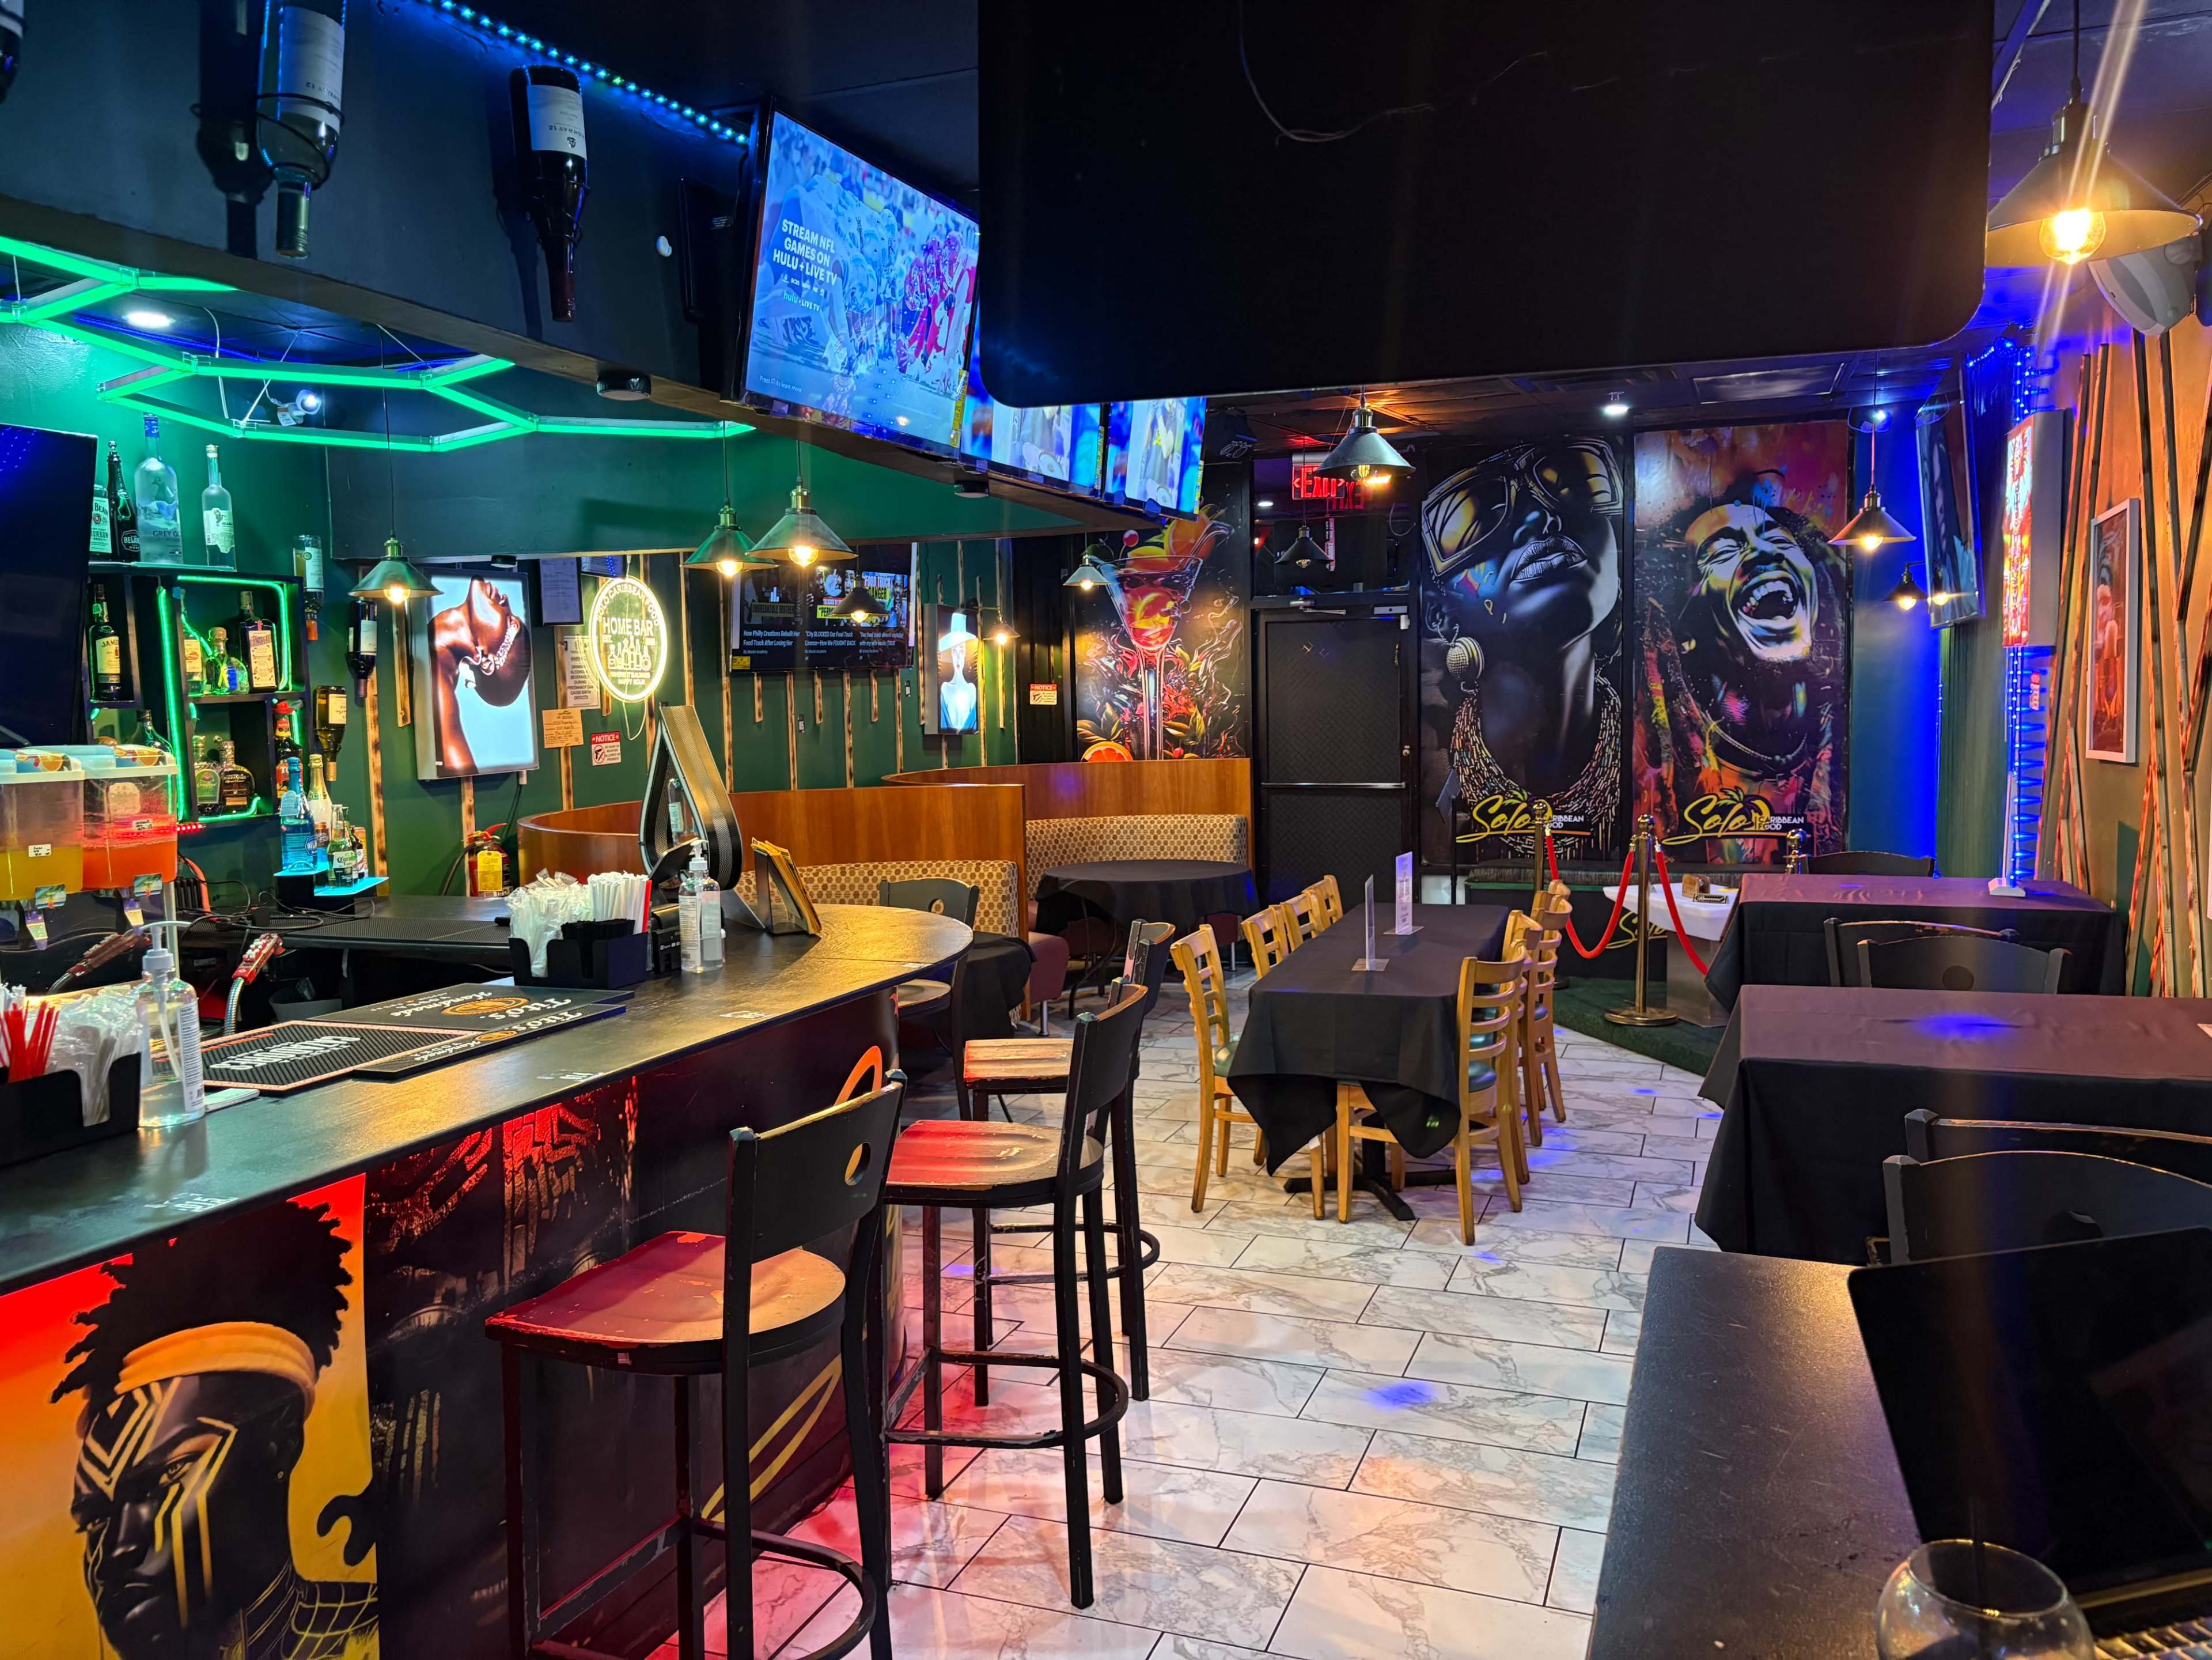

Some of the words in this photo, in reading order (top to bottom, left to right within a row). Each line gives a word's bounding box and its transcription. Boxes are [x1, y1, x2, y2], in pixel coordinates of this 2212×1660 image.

[782, 219, 819, 245] STREAM
[820, 236, 835, 253] NFL
[785, 237, 816, 260] GAMES
[817, 251, 830, 267] ON
[773, 248, 798, 270] HULU
[805, 262, 825, 281] LIVE
[825, 270, 838, 285] TV
[783, 290, 798, 303] hulu
[802, 300, 813, 309] LIVE
[153, 530, 171, 538] GREY
[608, 584, 646, 600] CARIBBEAN
[603, 617, 632, 635] HOME
[633, 619, 654, 637] BAR
[101, 639, 119, 648] JAME
[596, 734, 616, 743] NOTICE
[1456, 795, 1535, 843] Solo
[1552, 815, 1585, 823] RIBBEAN
[1661, 795, 1751, 845] Solo
[1759, 816, 1804, 824] CARIBBEAN
[1759, 822, 1782, 830] FOOD
[390, 991, 493, 1017] Handmade
[414, 1041, 482, 1061] Handmade
